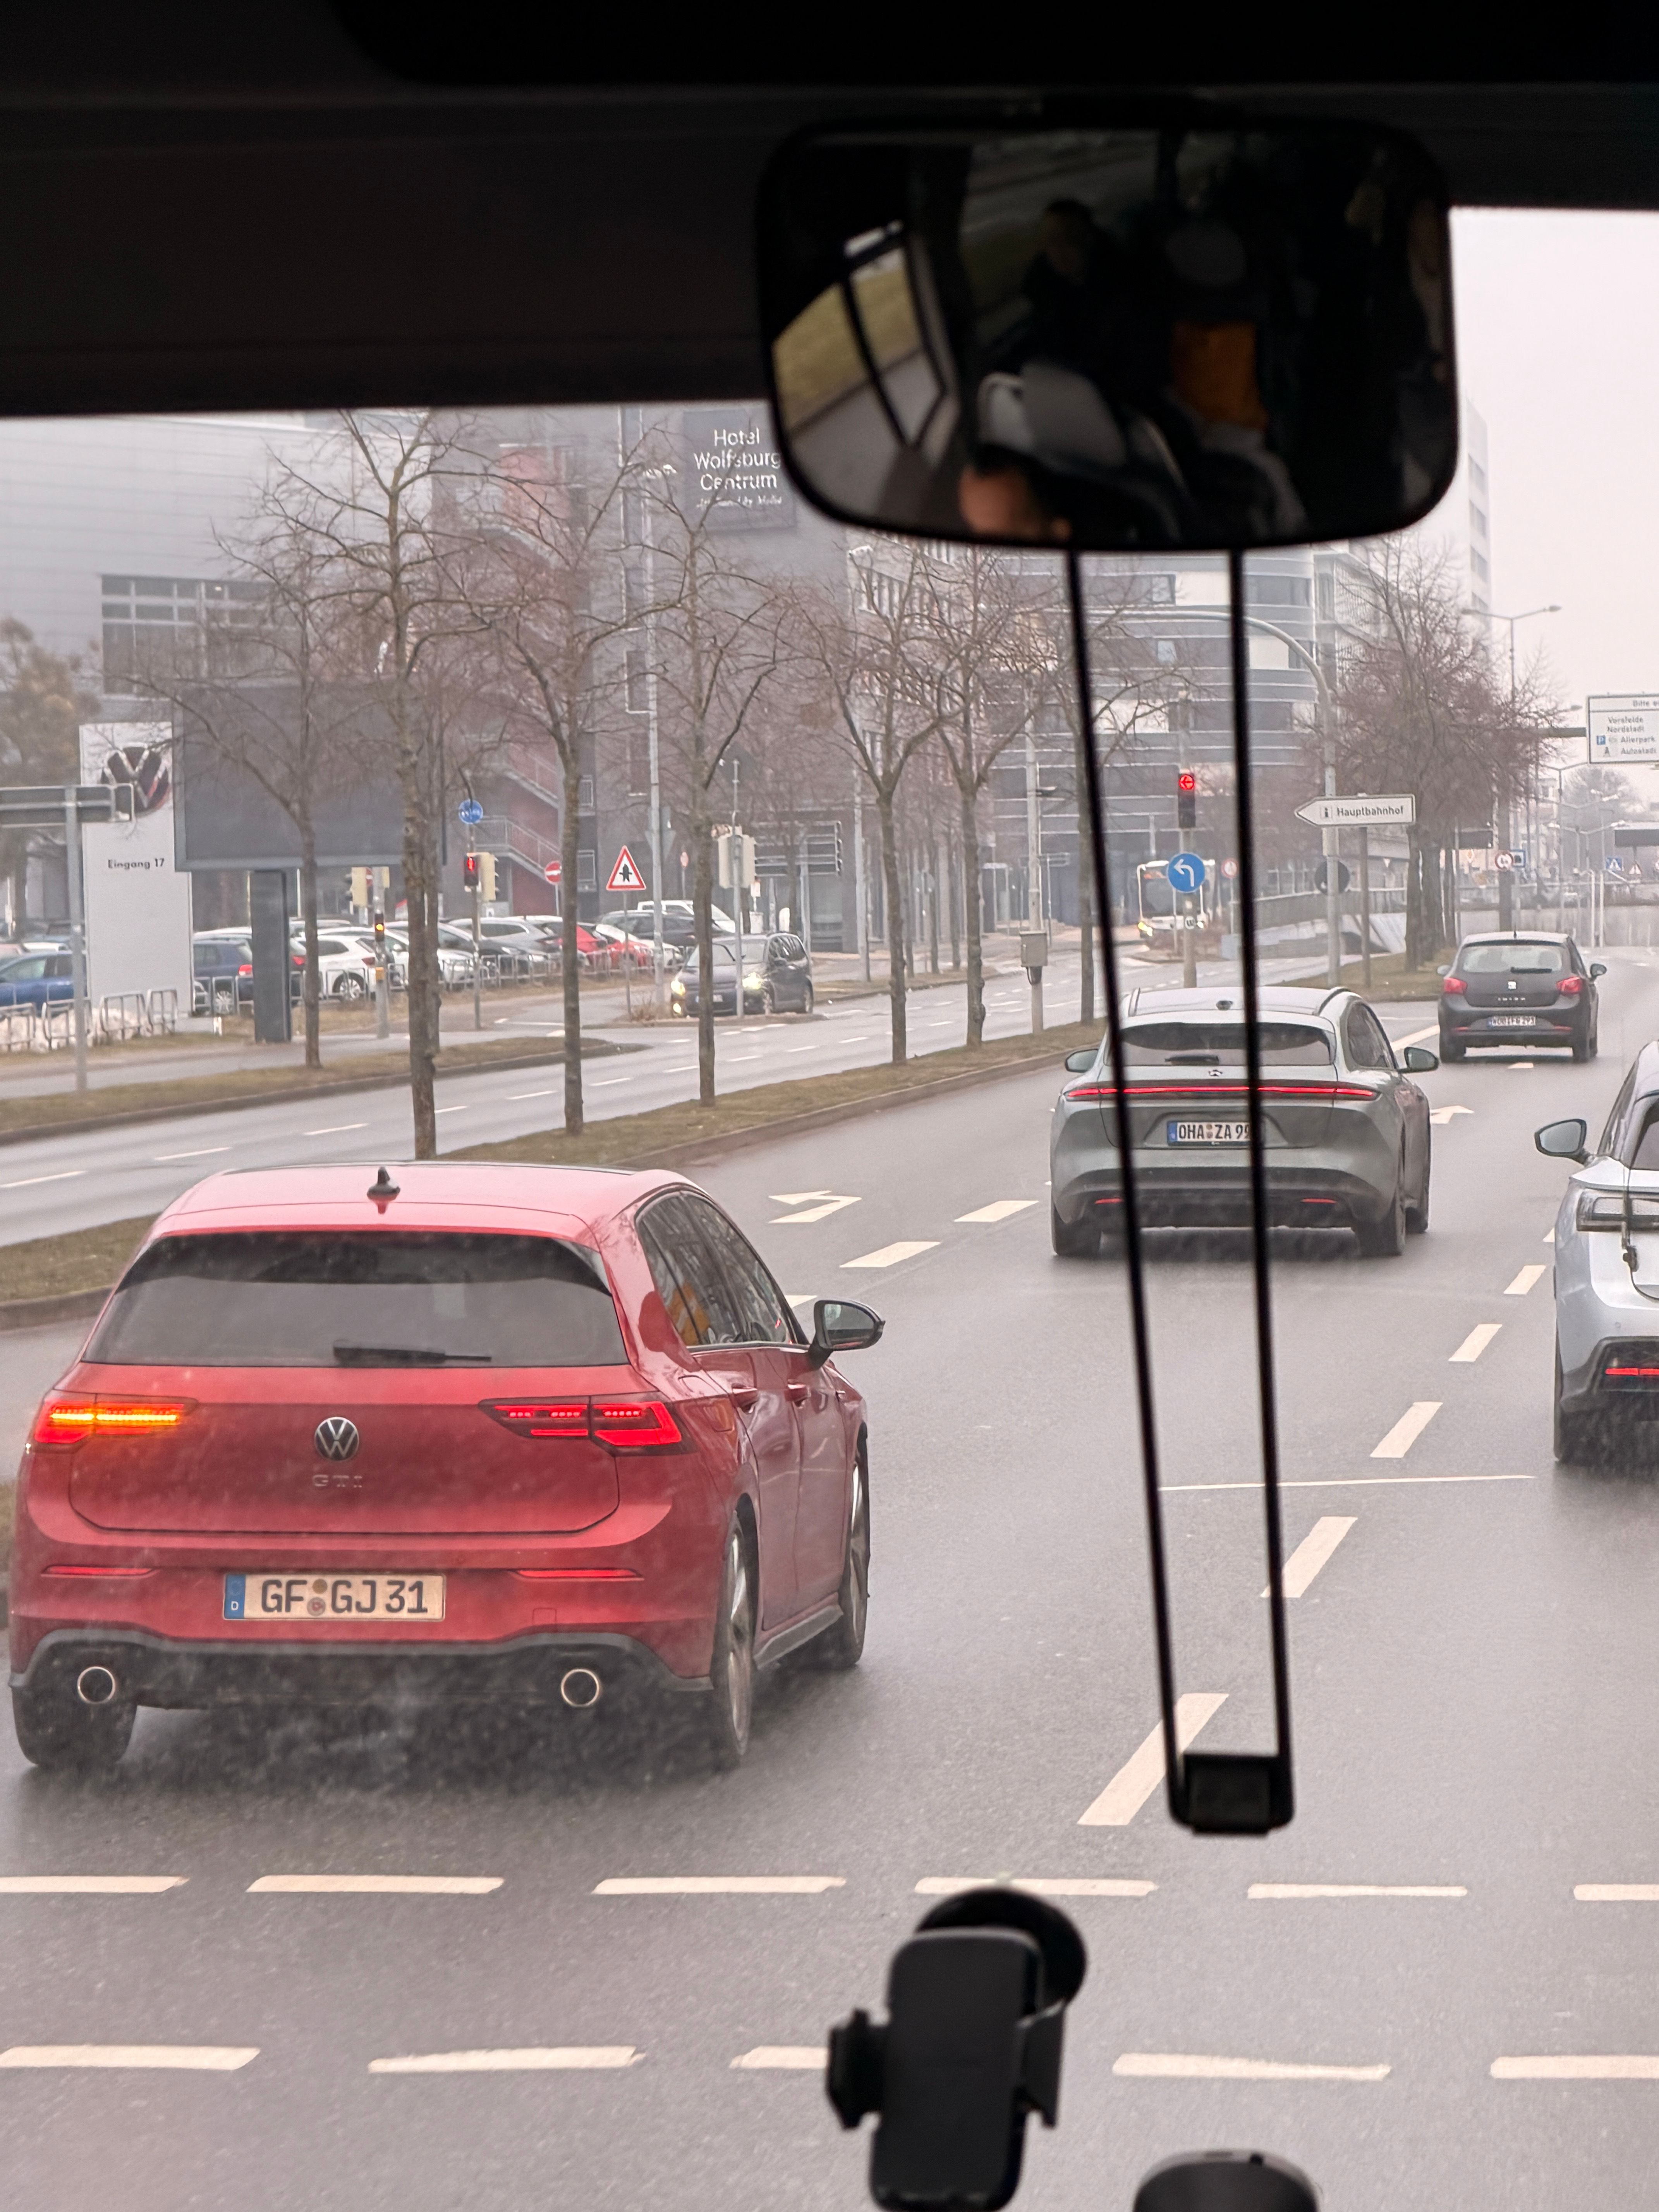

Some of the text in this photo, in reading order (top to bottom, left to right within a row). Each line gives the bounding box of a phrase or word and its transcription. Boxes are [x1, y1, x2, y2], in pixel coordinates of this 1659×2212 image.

[714, 427, 759, 447] Hotel
[694, 449, 781, 470] Wolfsburg
[700, 473, 777, 491] Centrum
[1337, 805, 1403, 817] Hauptbahnhof
[108, 858, 164, 869] Eingang 17
[1179, 1125, 1204, 1139] OHA
[1215, 1125, 1232, 1139] ZA
[313, 1475, 362, 1488] GTI
[231, 1580, 428, 1613] D GF GJ 31
